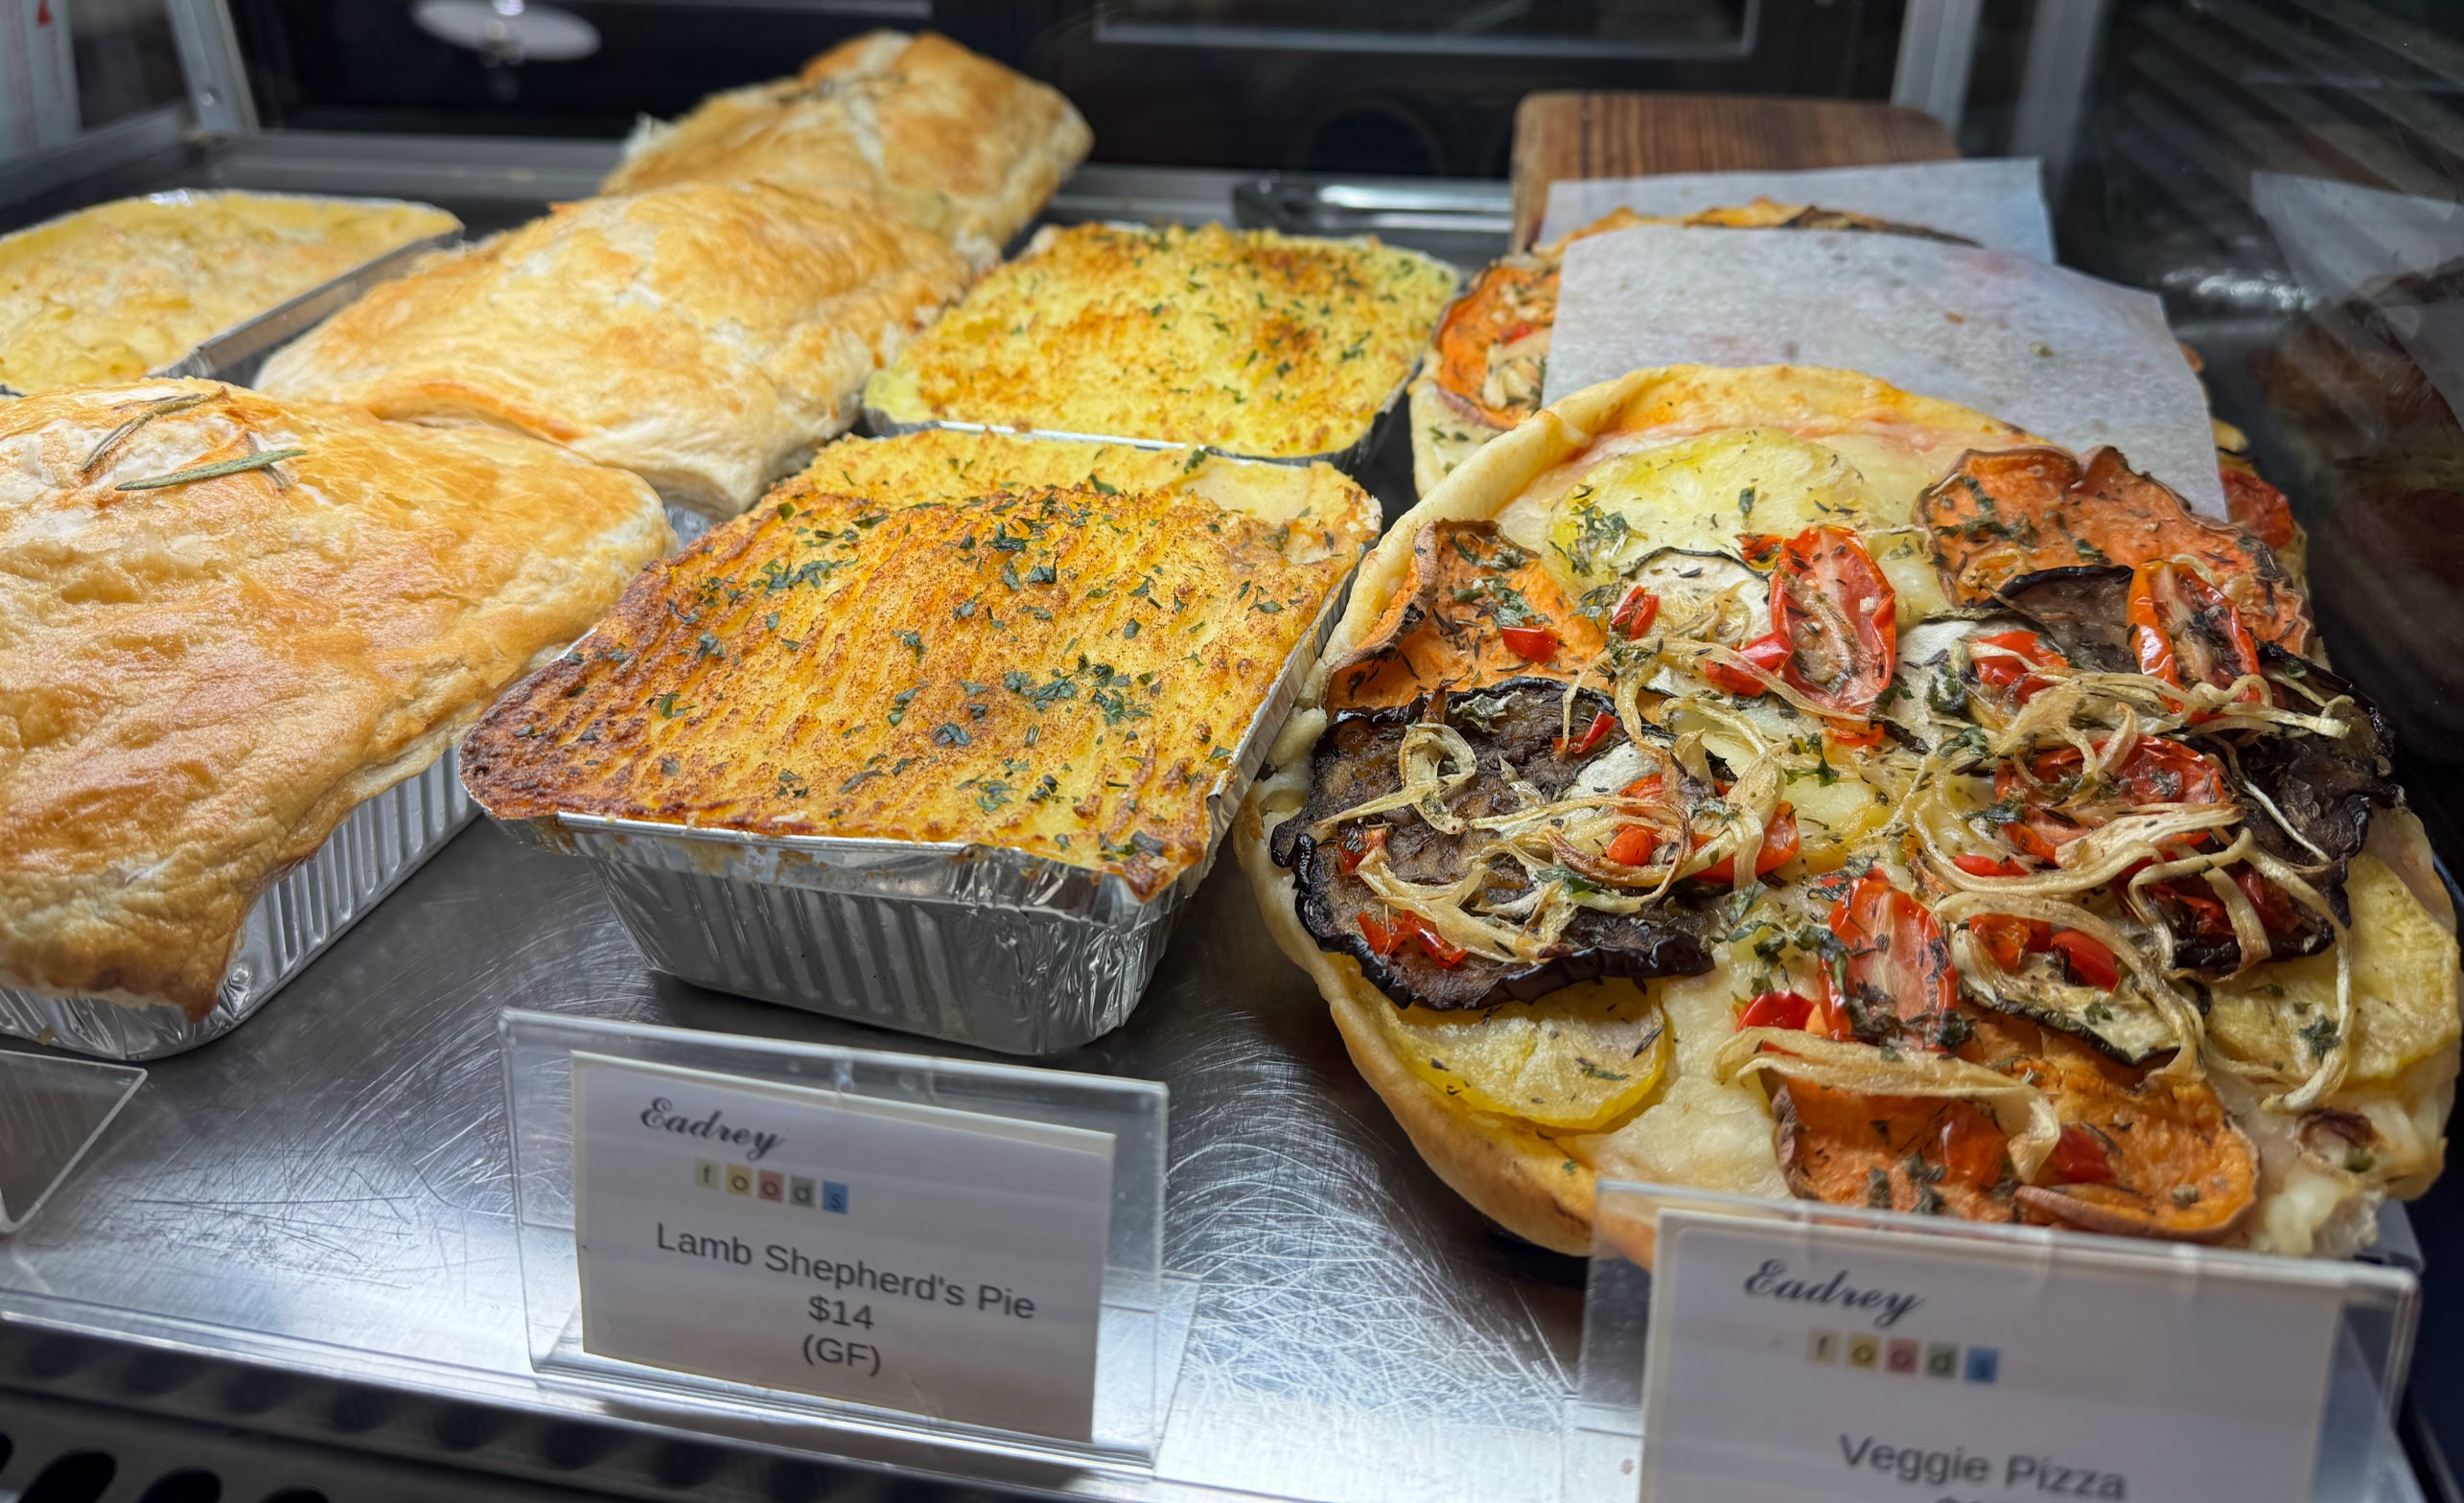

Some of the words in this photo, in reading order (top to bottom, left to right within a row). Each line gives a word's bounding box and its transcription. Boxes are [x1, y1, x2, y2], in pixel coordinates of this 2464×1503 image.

[640, 1097, 788, 1162] Eadrey
[701, 1163, 843, 1211] foods
[657, 1222, 753, 1266] Lamb
[764, 1244, 965, 1306] Shepherd's
[976, 1283, 1036, 1320] Pie
[1743, 1258, 1925, 1329] Eadrey
[807, 1295, 875, 1330] $14
[802, 1333, 882, 1377] (GF)
[1816, 1333, 1990, 1380] foods
[1839, 1433, 1990, 1486] Veggie
[2005, 1453, 2127, 1501] Pizza
